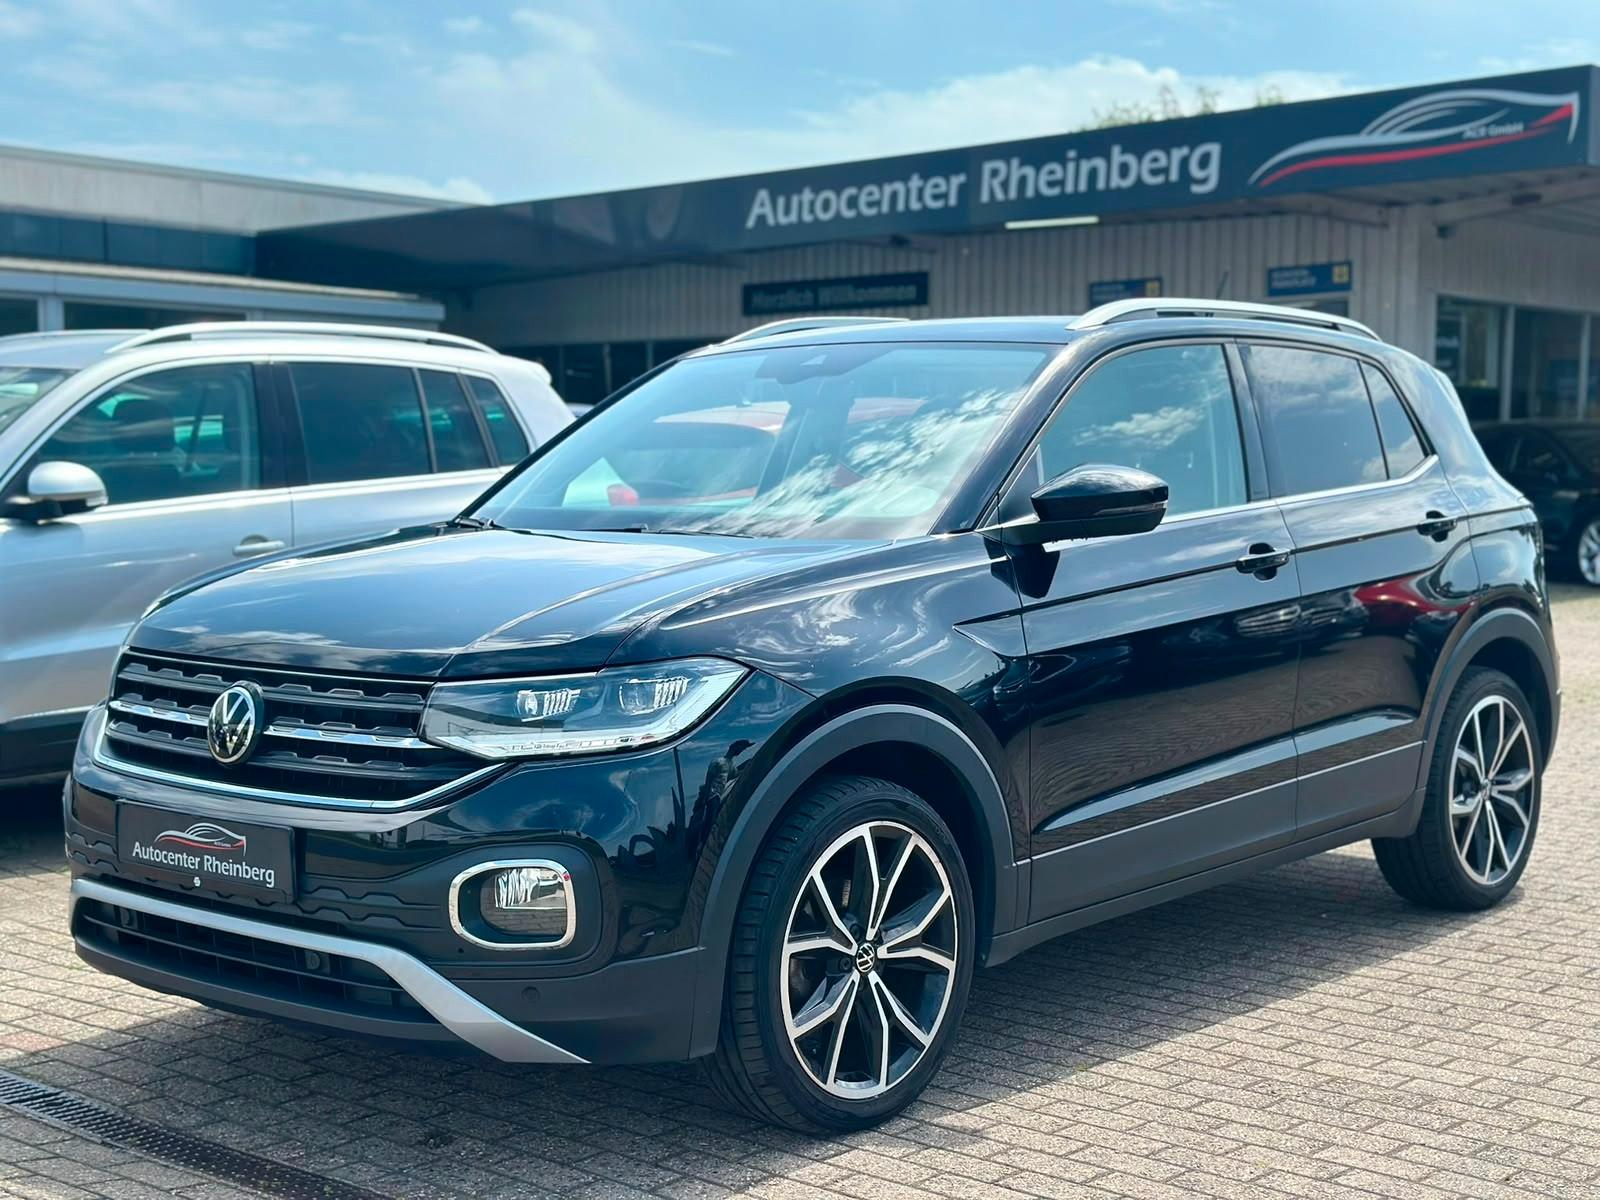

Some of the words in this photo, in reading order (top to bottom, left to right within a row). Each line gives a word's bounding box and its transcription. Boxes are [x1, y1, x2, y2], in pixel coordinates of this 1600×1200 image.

[745, 172, 968, 230] Autocenter
[979, 141, 1222, 204] Rheinberg
[132, 841, 200, 870] Autocenter
[204, 855, 275, 888] Rheinberg
